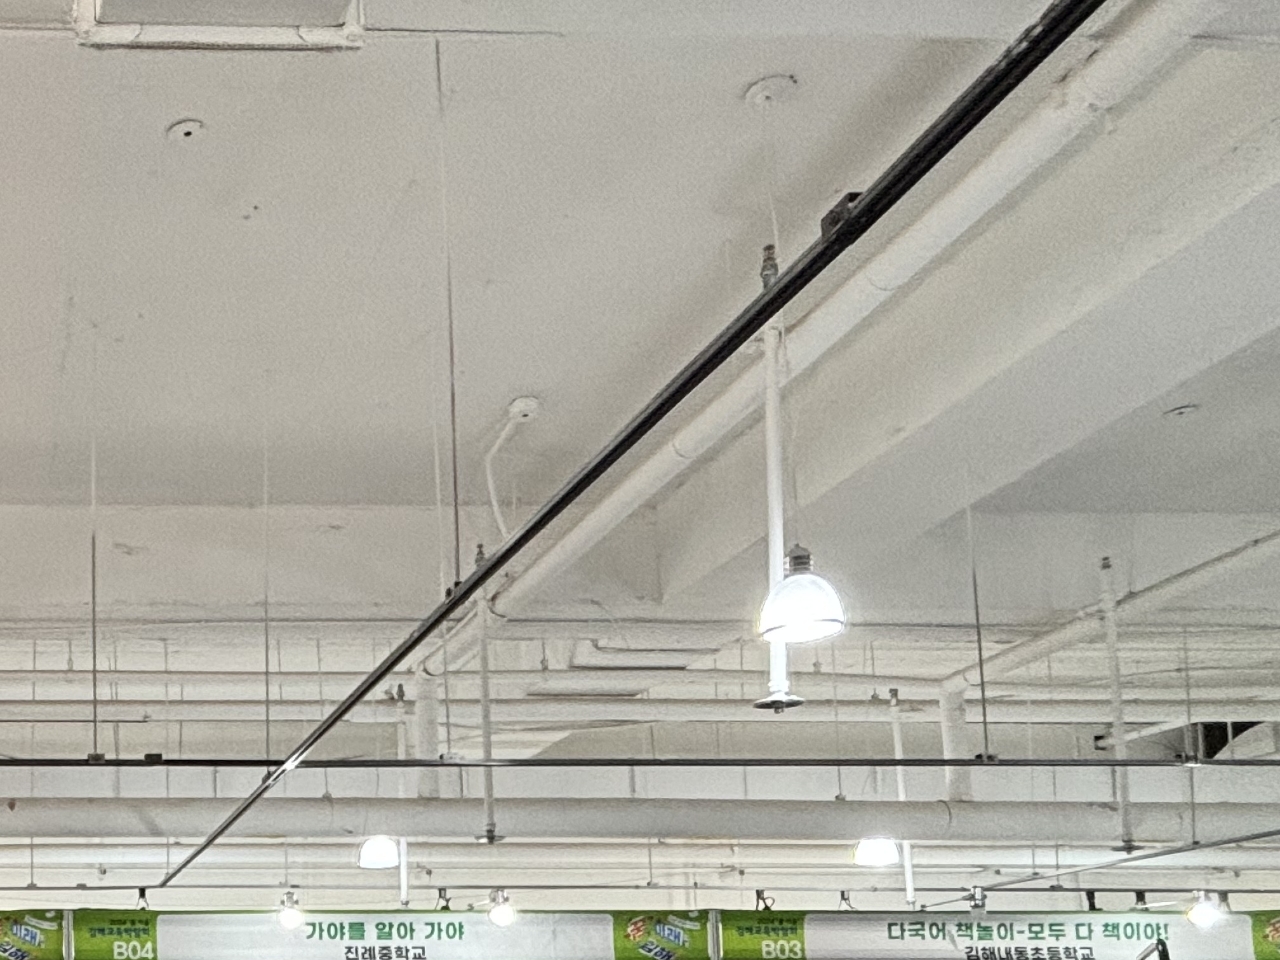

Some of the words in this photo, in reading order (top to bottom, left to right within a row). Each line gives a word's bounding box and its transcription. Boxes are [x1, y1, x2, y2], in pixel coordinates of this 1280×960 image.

[306, 921, 366, 940] 가야를
[375, 921, 415, 940] 알아
[424, 921, 464, 940] 가야
[887, 922, 946, 940] 다국어
[956, 922, 1066, 940] 책놀이-모두
[1075, 922, 1093, 940] 다
[1102, 922, 1169, 941] 책이야!
[113, 941, 154, 960] B04
[761, 940, 803, 959] B03
